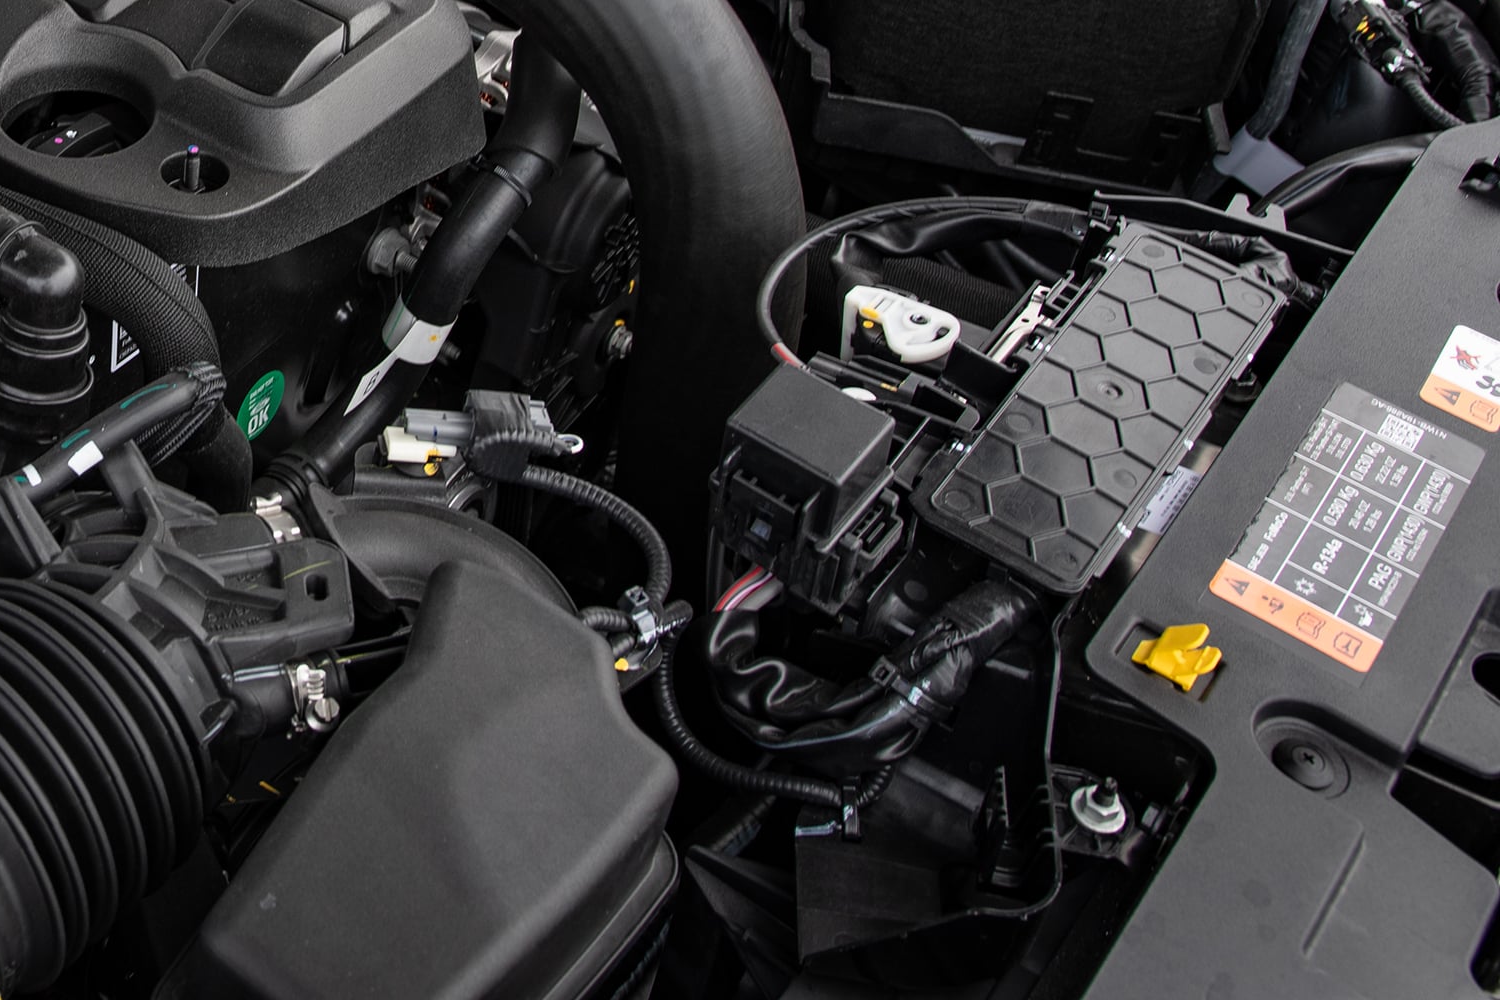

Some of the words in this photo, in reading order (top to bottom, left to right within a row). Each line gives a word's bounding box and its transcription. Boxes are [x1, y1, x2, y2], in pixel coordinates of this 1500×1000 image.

[248, 407, 269, 435] OK
[1350, 455, 1373, 481] 0.630
[1366, 441, 1386, 459] Kg
[1340, 485, 1360, 504] Kg
[1264, 511, 1288, 542] FoMoCo
[1312, 539, 1343, 575] R-134a
[1368, 564, 1393, 591] PAG
